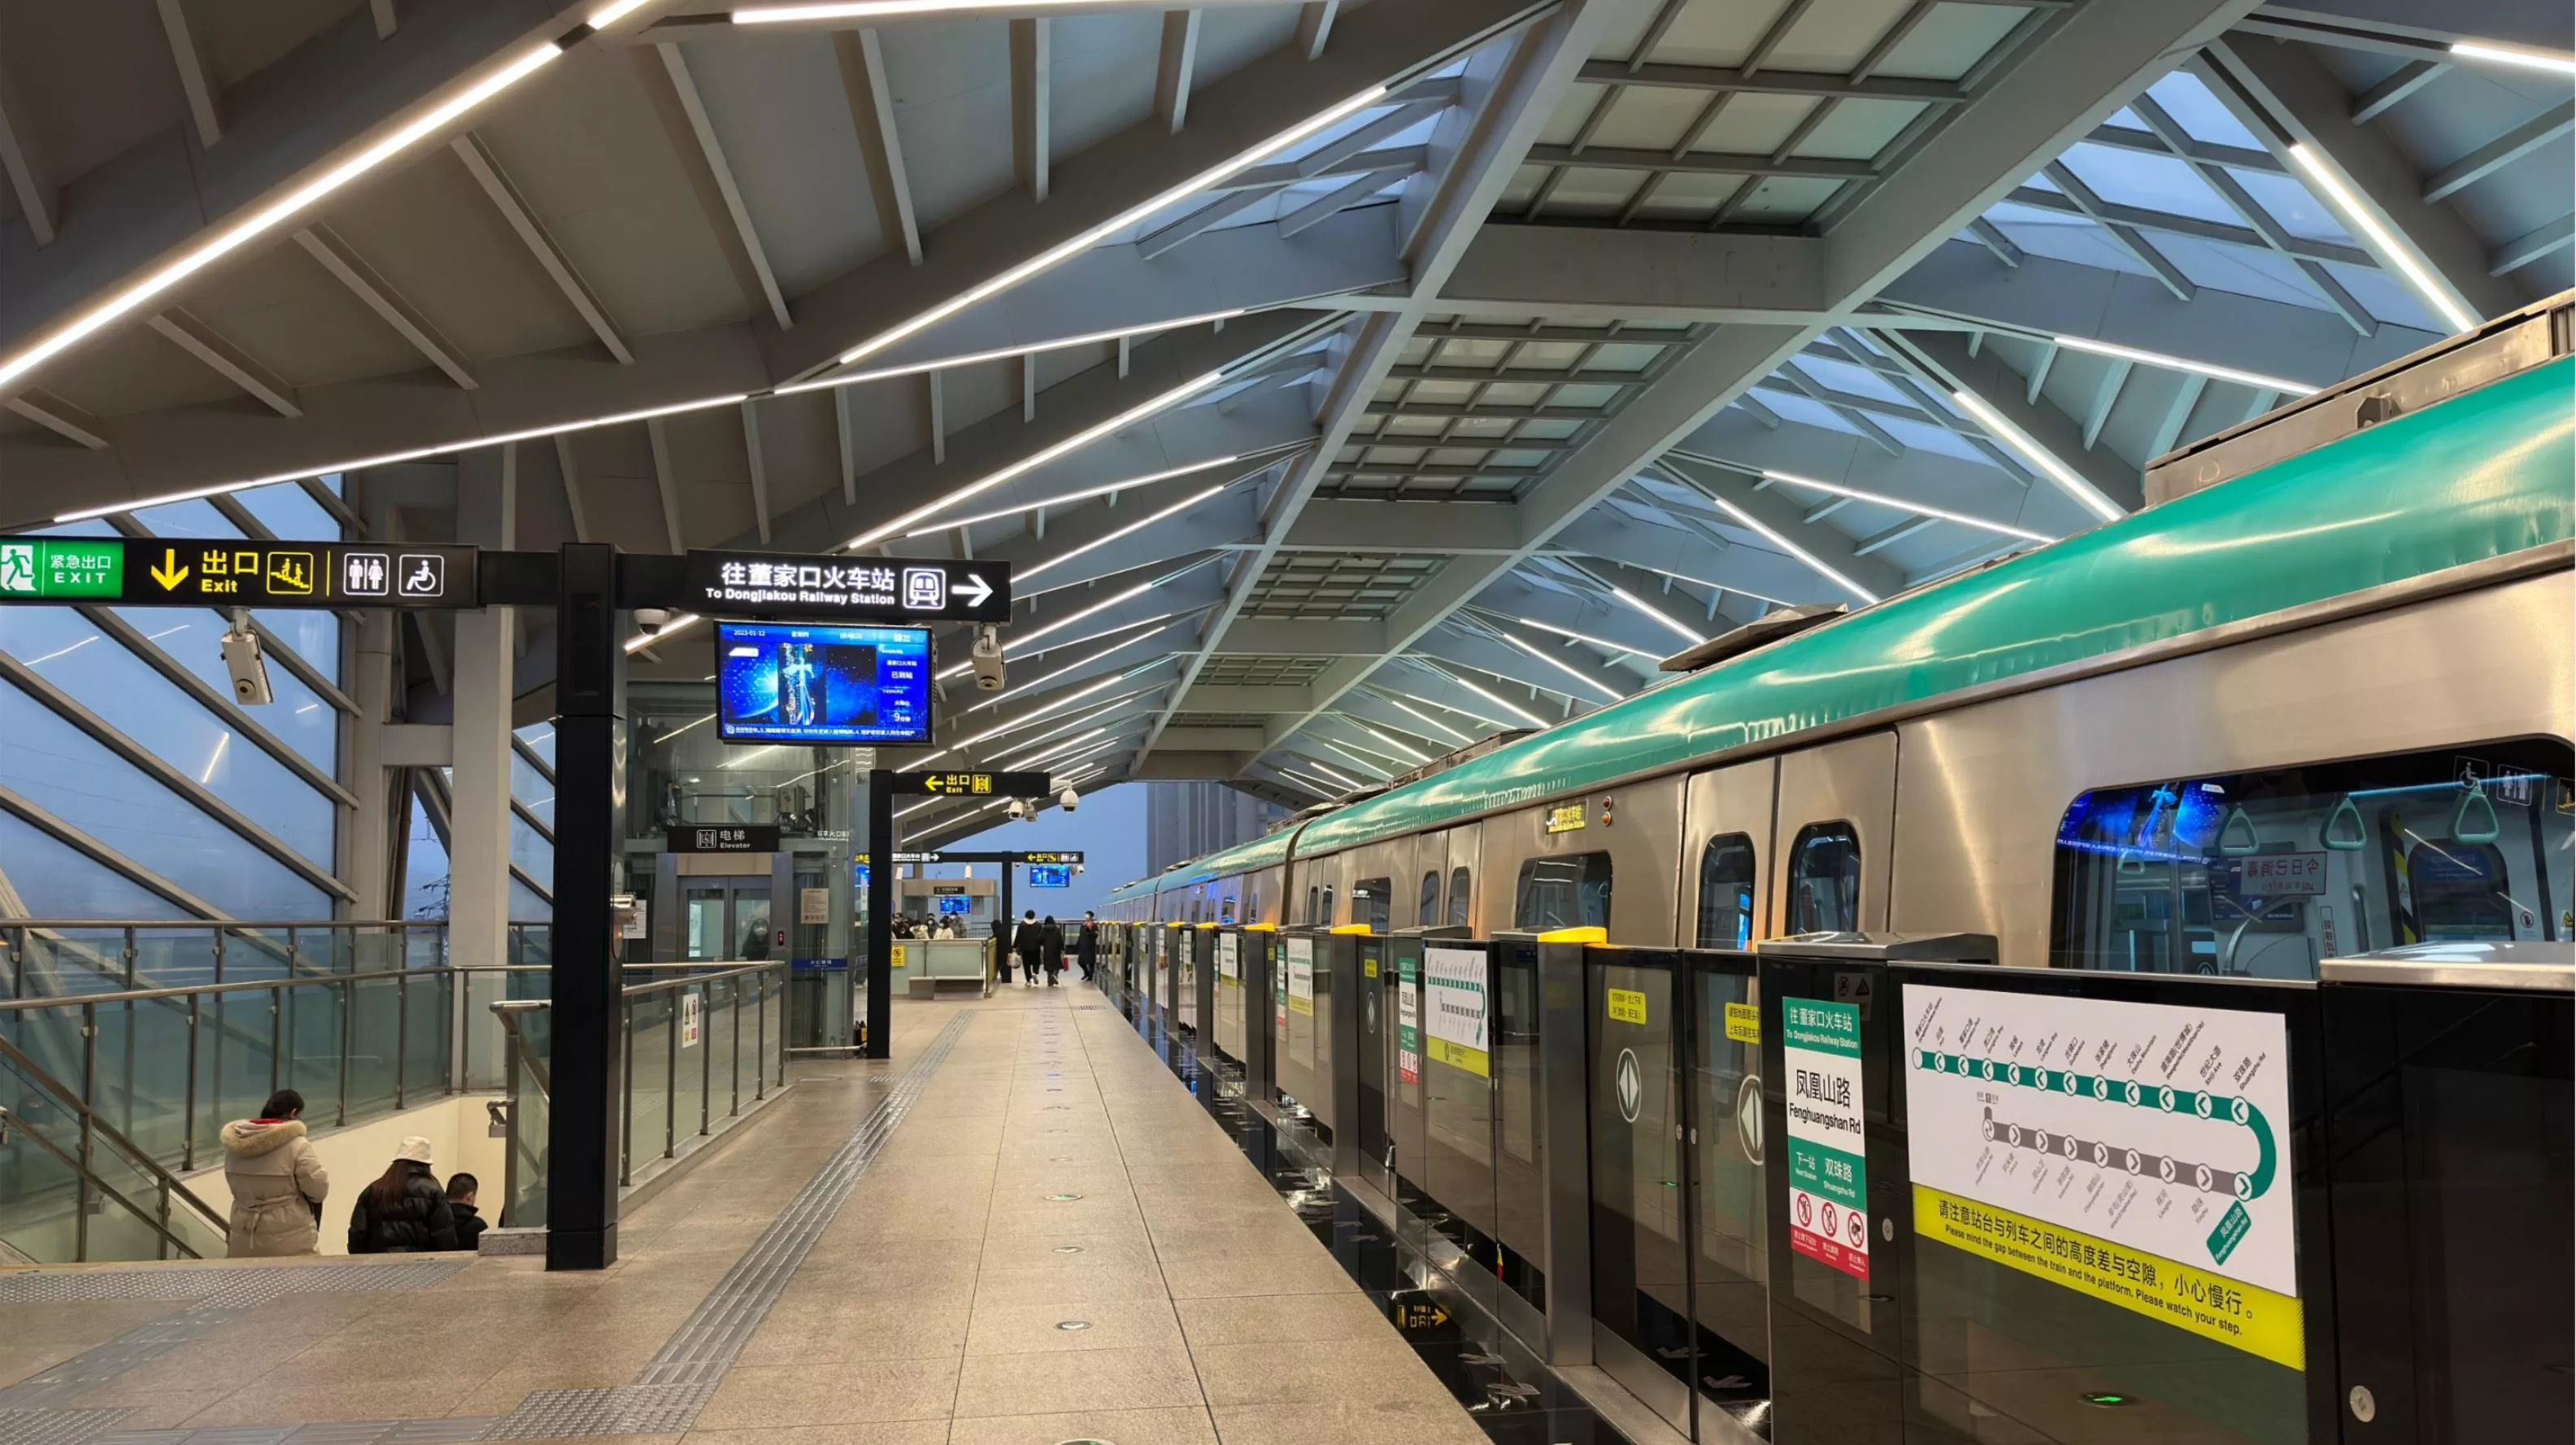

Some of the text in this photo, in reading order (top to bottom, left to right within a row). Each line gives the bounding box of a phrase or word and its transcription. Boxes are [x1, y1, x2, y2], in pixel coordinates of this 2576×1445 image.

[50, 555, 111, 569] 紧急出口
[202, 550, 259, 575] 出口
[54, 572, 107, 584] EXIT
[201, 579, 237, 593] Exit
[722, 562, 895, 591] 往董家口火车站
[706, 588, 894, 605] To Dongjiakou Railway Station
[946, 773, 969, 785] 出口
[720, 829, 745, 841] 电梯
[1790, 1006, 1852, 1032] 往董家口火车站
[1786, 1029, 1792, 1038] To
[1821, 1034, 1839, 1047] Railway
[1839, 1037, 1858, 1049] Station
[2199, 1045, 2221, 1077] 世纪大道
[2233, 1056, 2252, 1082] 双珠路
[1796, 1069, 1851, 1109] 凤凰山路
[1789, 1102, 1861, 1134] Fenghuangshan Rd
[1795, 1151, 1816, 1170] 下一站
[1825, 1157, 1852, 1183] 双珠路
[1939, 1199, 2252, 1319] 请注意站台与列车之间的高度差与空隙，小心慢行。
[1945, 1225, 2243, 1336] Please mind the gap between the train and the platform. Please watch your step.
